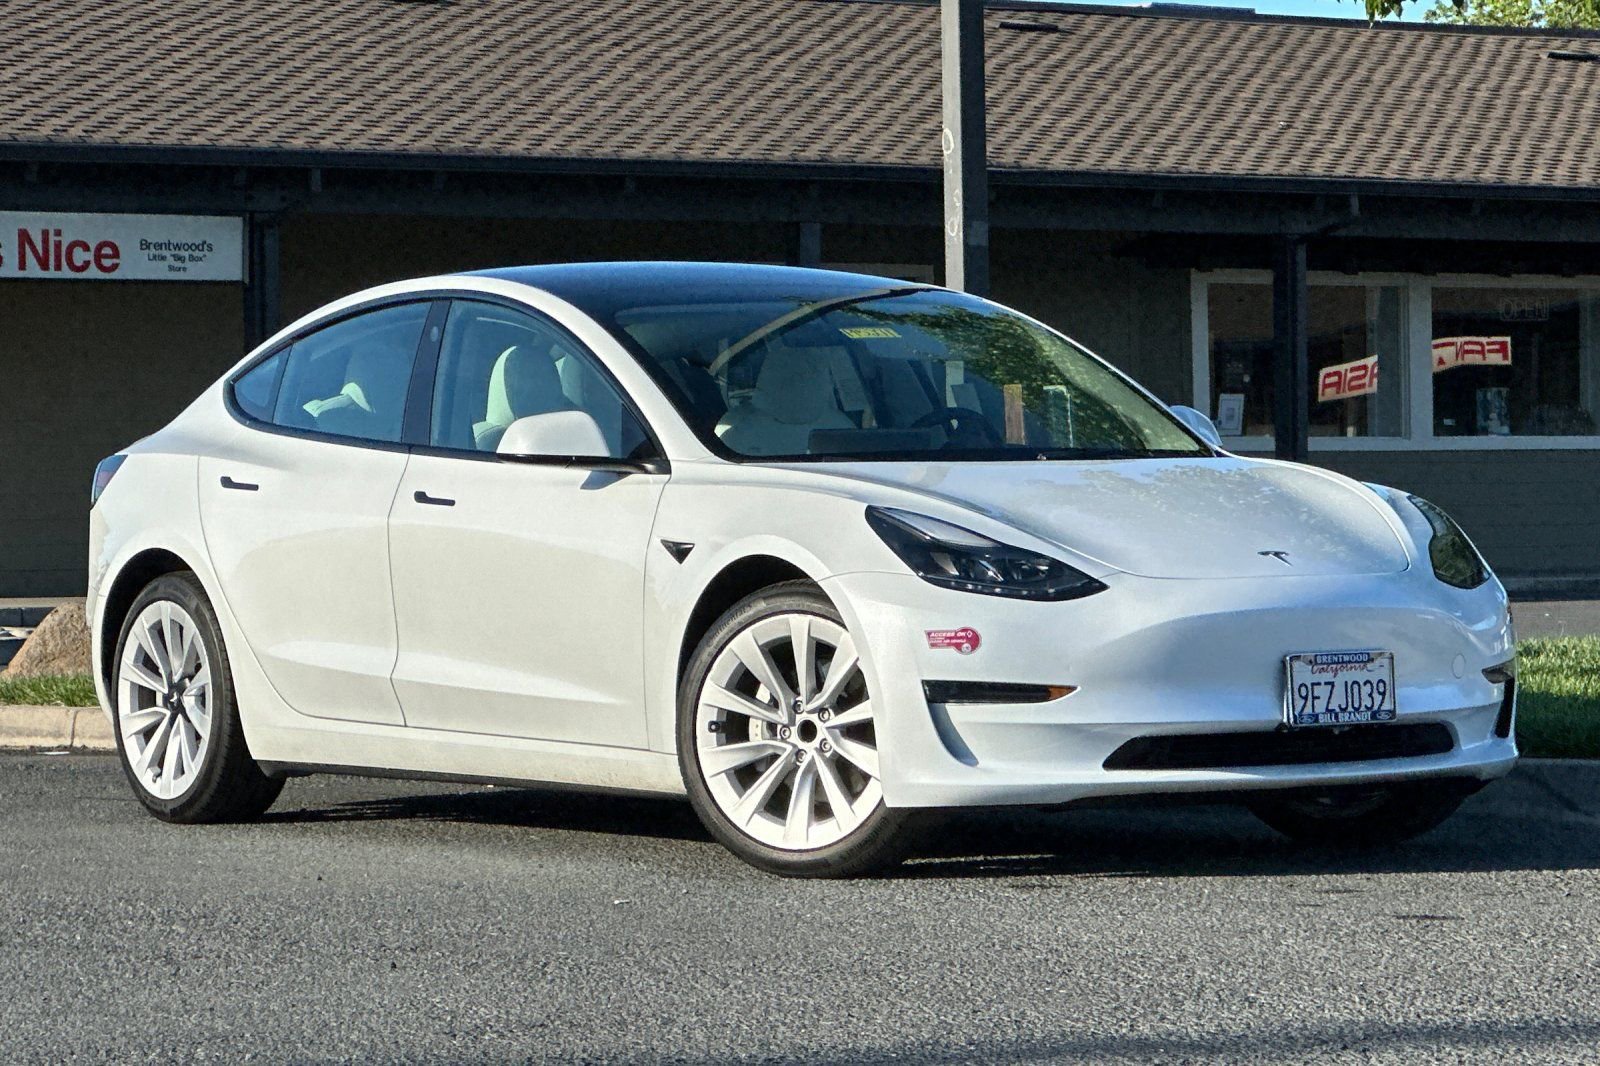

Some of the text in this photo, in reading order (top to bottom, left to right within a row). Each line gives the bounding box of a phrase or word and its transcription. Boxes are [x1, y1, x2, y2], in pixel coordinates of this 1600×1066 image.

[18, 228, 120, 273] Nice
[139, 239, 213, 252] Brentwood's
[147, 253, 167, 262] Little
[167, 264, 187, 273] Store
[1316, 653, 1369, 664] BRENTWOOD
[1298, 679, 1387, 714] 9FZJ039
[1318, 713, 1337, 723] BILL
